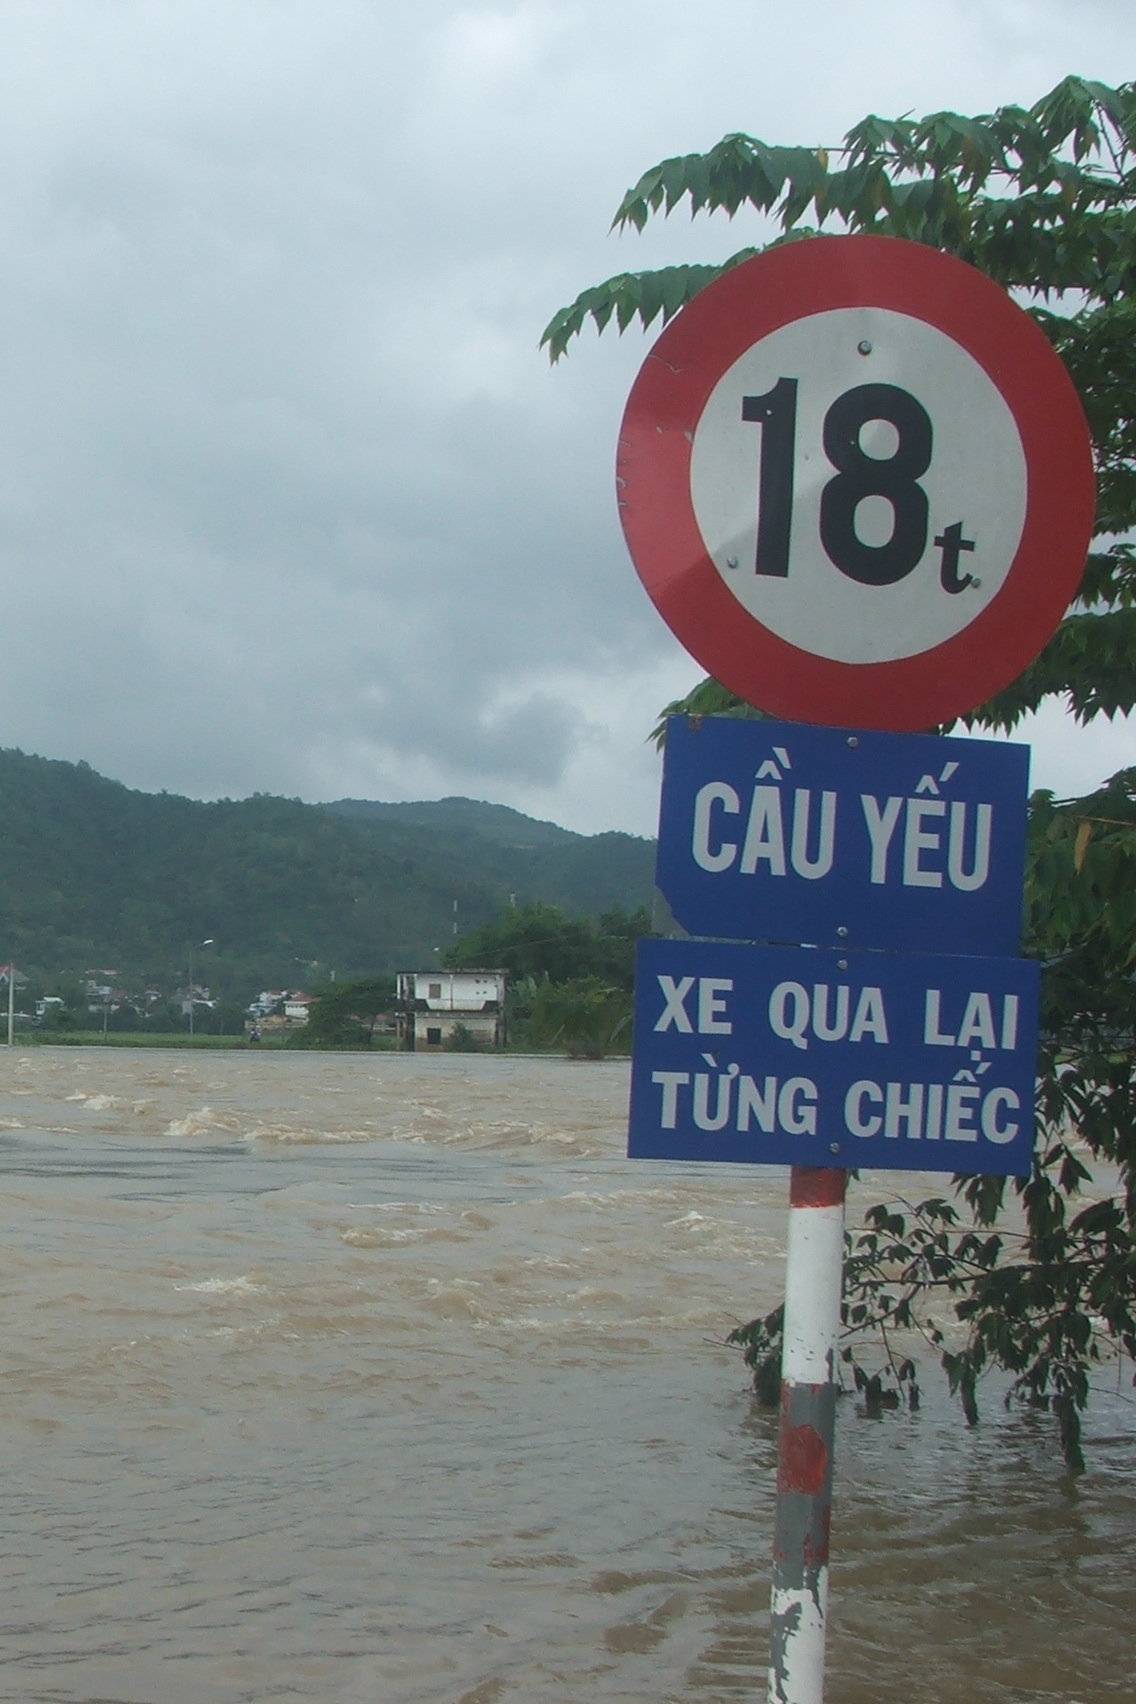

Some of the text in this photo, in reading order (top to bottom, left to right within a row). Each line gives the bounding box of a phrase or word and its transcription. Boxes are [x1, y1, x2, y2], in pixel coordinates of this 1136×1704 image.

[692, 747, 992, 892] CẦU YẾU
[653, 974, 1019, 1061] XE QUA LẠI
[651, 1052, 1020, 1145] TỪNG CHIẾC
